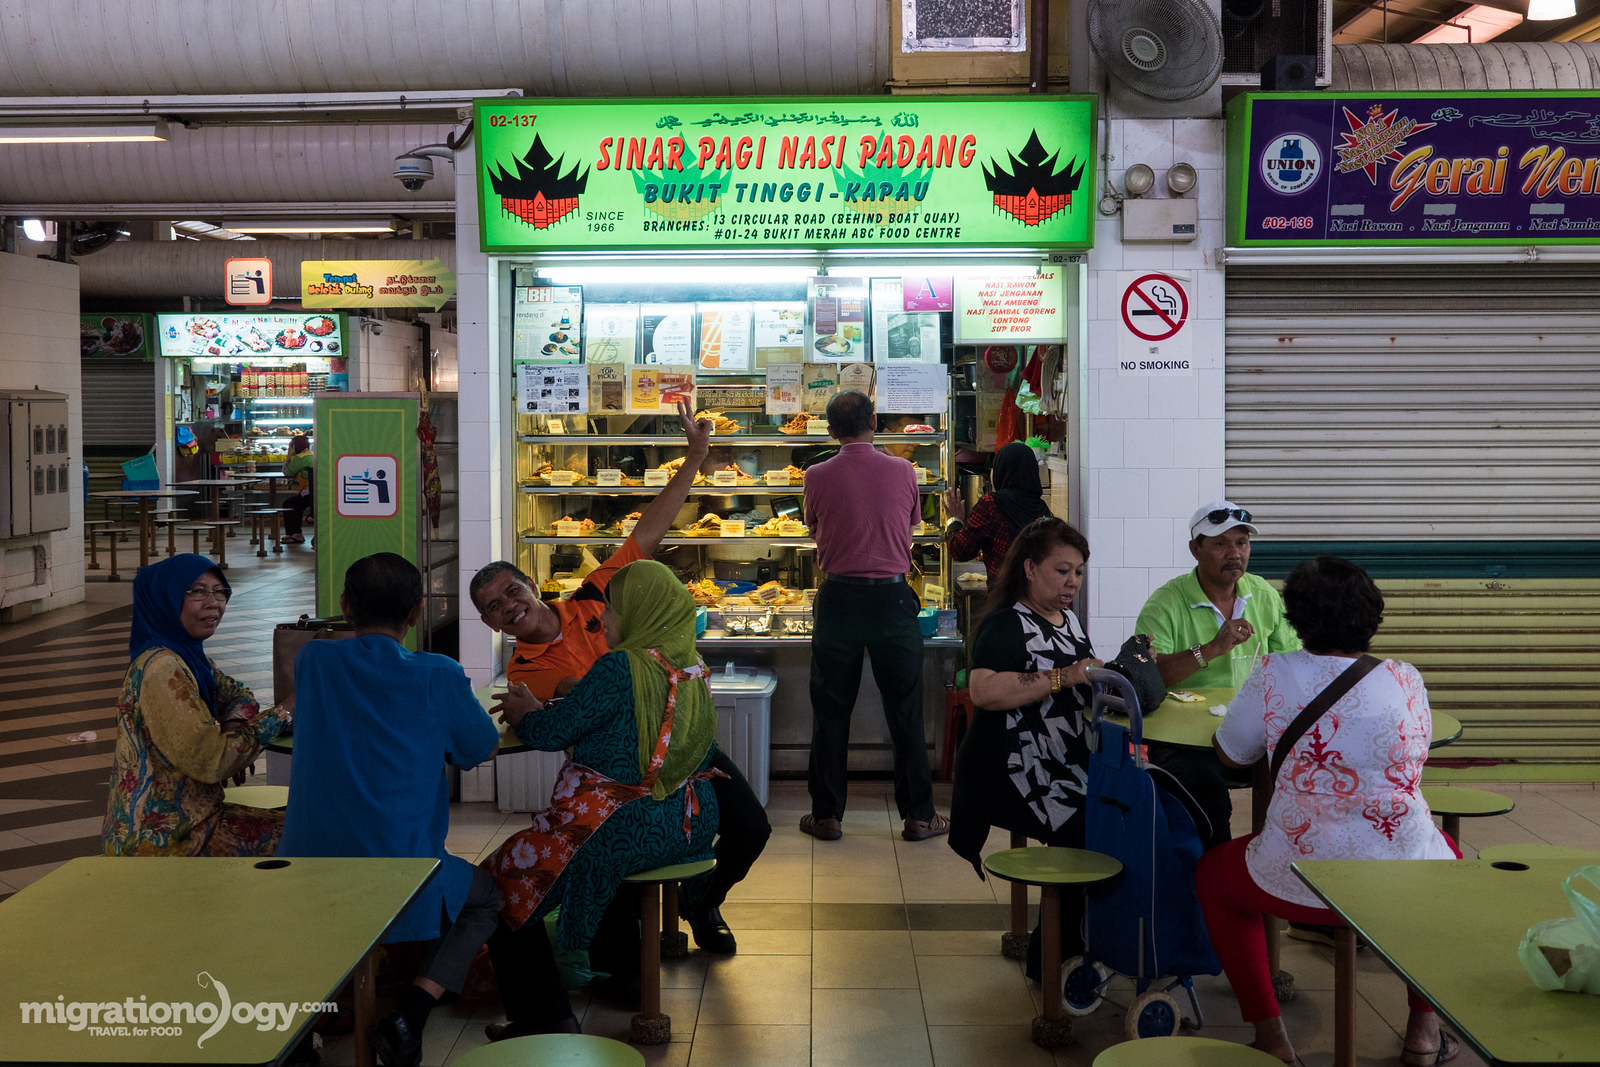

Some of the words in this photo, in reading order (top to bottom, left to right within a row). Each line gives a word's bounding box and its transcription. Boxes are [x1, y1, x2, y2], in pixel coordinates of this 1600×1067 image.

[490, 114, 538, 127] 02-137
[1354, 118, 1387, 142] NO.1
[1338, 140, 1369, 161] Nasi
[1369, 116, 1409, 151] Rawon
[597, 136, 685, 173] SINAR
[697, 136, 766, 170] PAGI
[777, 134, 846, 170] NASI
[859, 133, 977, 169] PADANG
[1337, 154, 1369, 173] Nasi
[1368, 119, 1417, 163] Jenganan
[1267, 159, 1316, 171] UNION
[1267, 172, 1279, 187] GROUP
[1389, 144, 1510, 213] Gerai
[644, 182, 722, 204] BUKIT
[586, 211, 625, 221] SINCE
[713, 214, 727, 226] 13
[731, 213, 789, 226] CIRCULAR
[793, 213, 826, 225] ROAD
[831, 212, 883, 225] (BEHIND
[888, 213, 920, 224] BOAT
[924, 212, 960, 225] QUAY)
[587, 222, 616, 233] 1966
[643, 220, 711, 233] BRANCHES:
[1262, 217, 1314, 230] #02-136
[1330, 219, 1358, 231] Nasi
[1360, 219, 1403, 231] Rawon
[1422, 219, 1451, 231] Nasi
[1451, 219, 1510, 233] Jenganan
[1529, 219, 1558, 231] Nasi
[714, 228, 759, 241] #01-24
[763, 228, 800, 241] BUKIT
[804, 228, 847, 240] MERAH
[852, 228, 875, 240] ABC
[880, 228, 910, 240] FOOD
[915, 227, 962, 239] CENTRE
[323, 273, 357, 285] Tempat
[528, 288, 552, 302] BH
[915, 277, 939, 299] A
[988, 308, 1020, 316] SAMBAL
[991, 325, 1007, 333] SUP
[1120, 361, 1136, 370] NO
[1139, 360, 1190, 370] SMOKING
